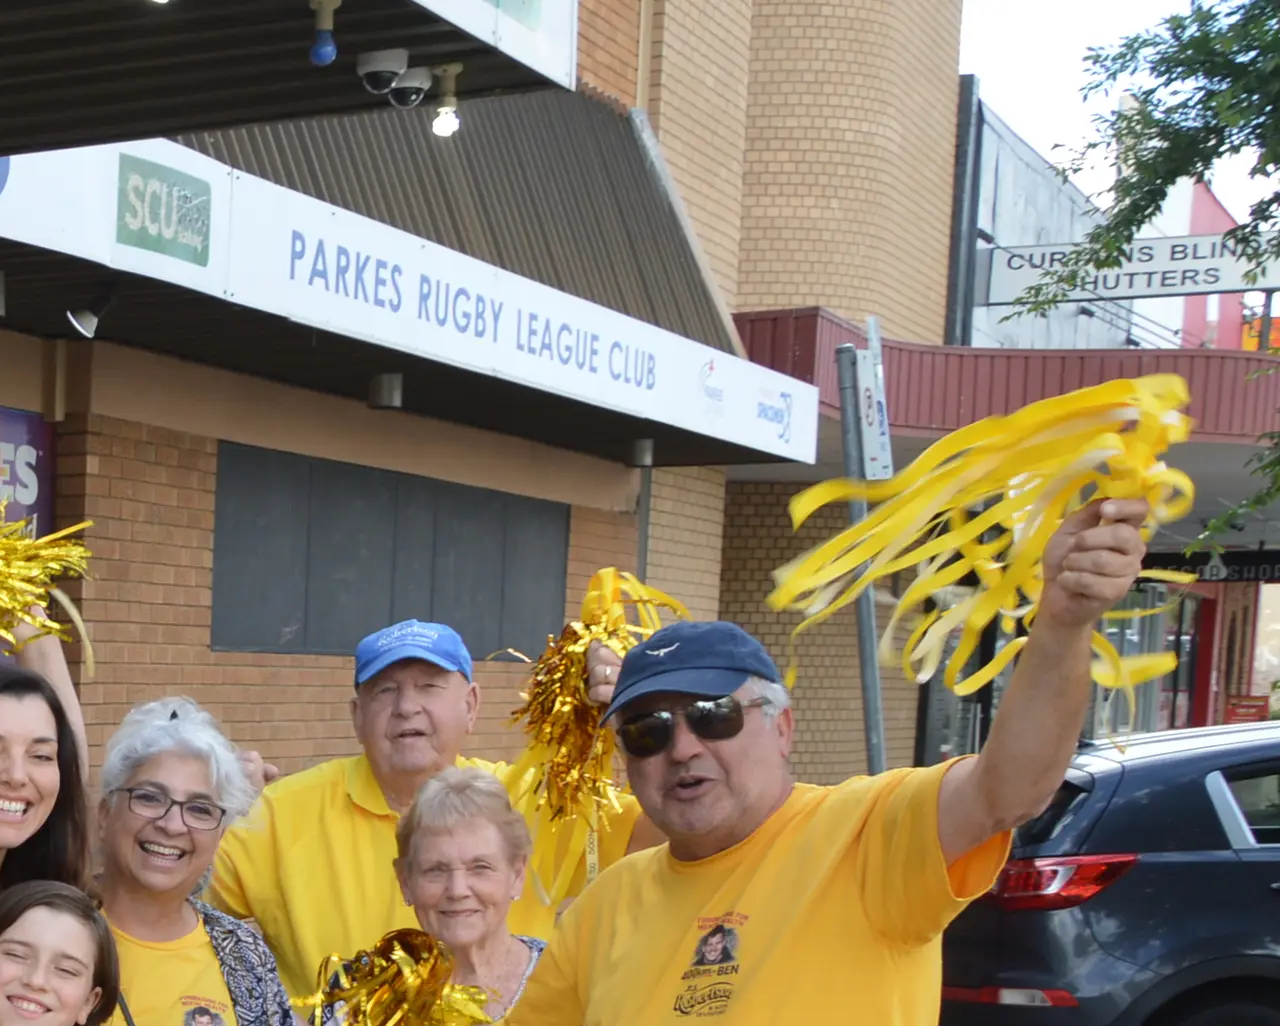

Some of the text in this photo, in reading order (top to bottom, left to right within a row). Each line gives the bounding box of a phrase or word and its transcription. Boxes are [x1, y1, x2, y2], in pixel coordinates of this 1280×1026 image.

[124, 173, 178, 239] SCU
[289, 229, 656, 391] PARKES RUGBY LEAGUE CLUB
